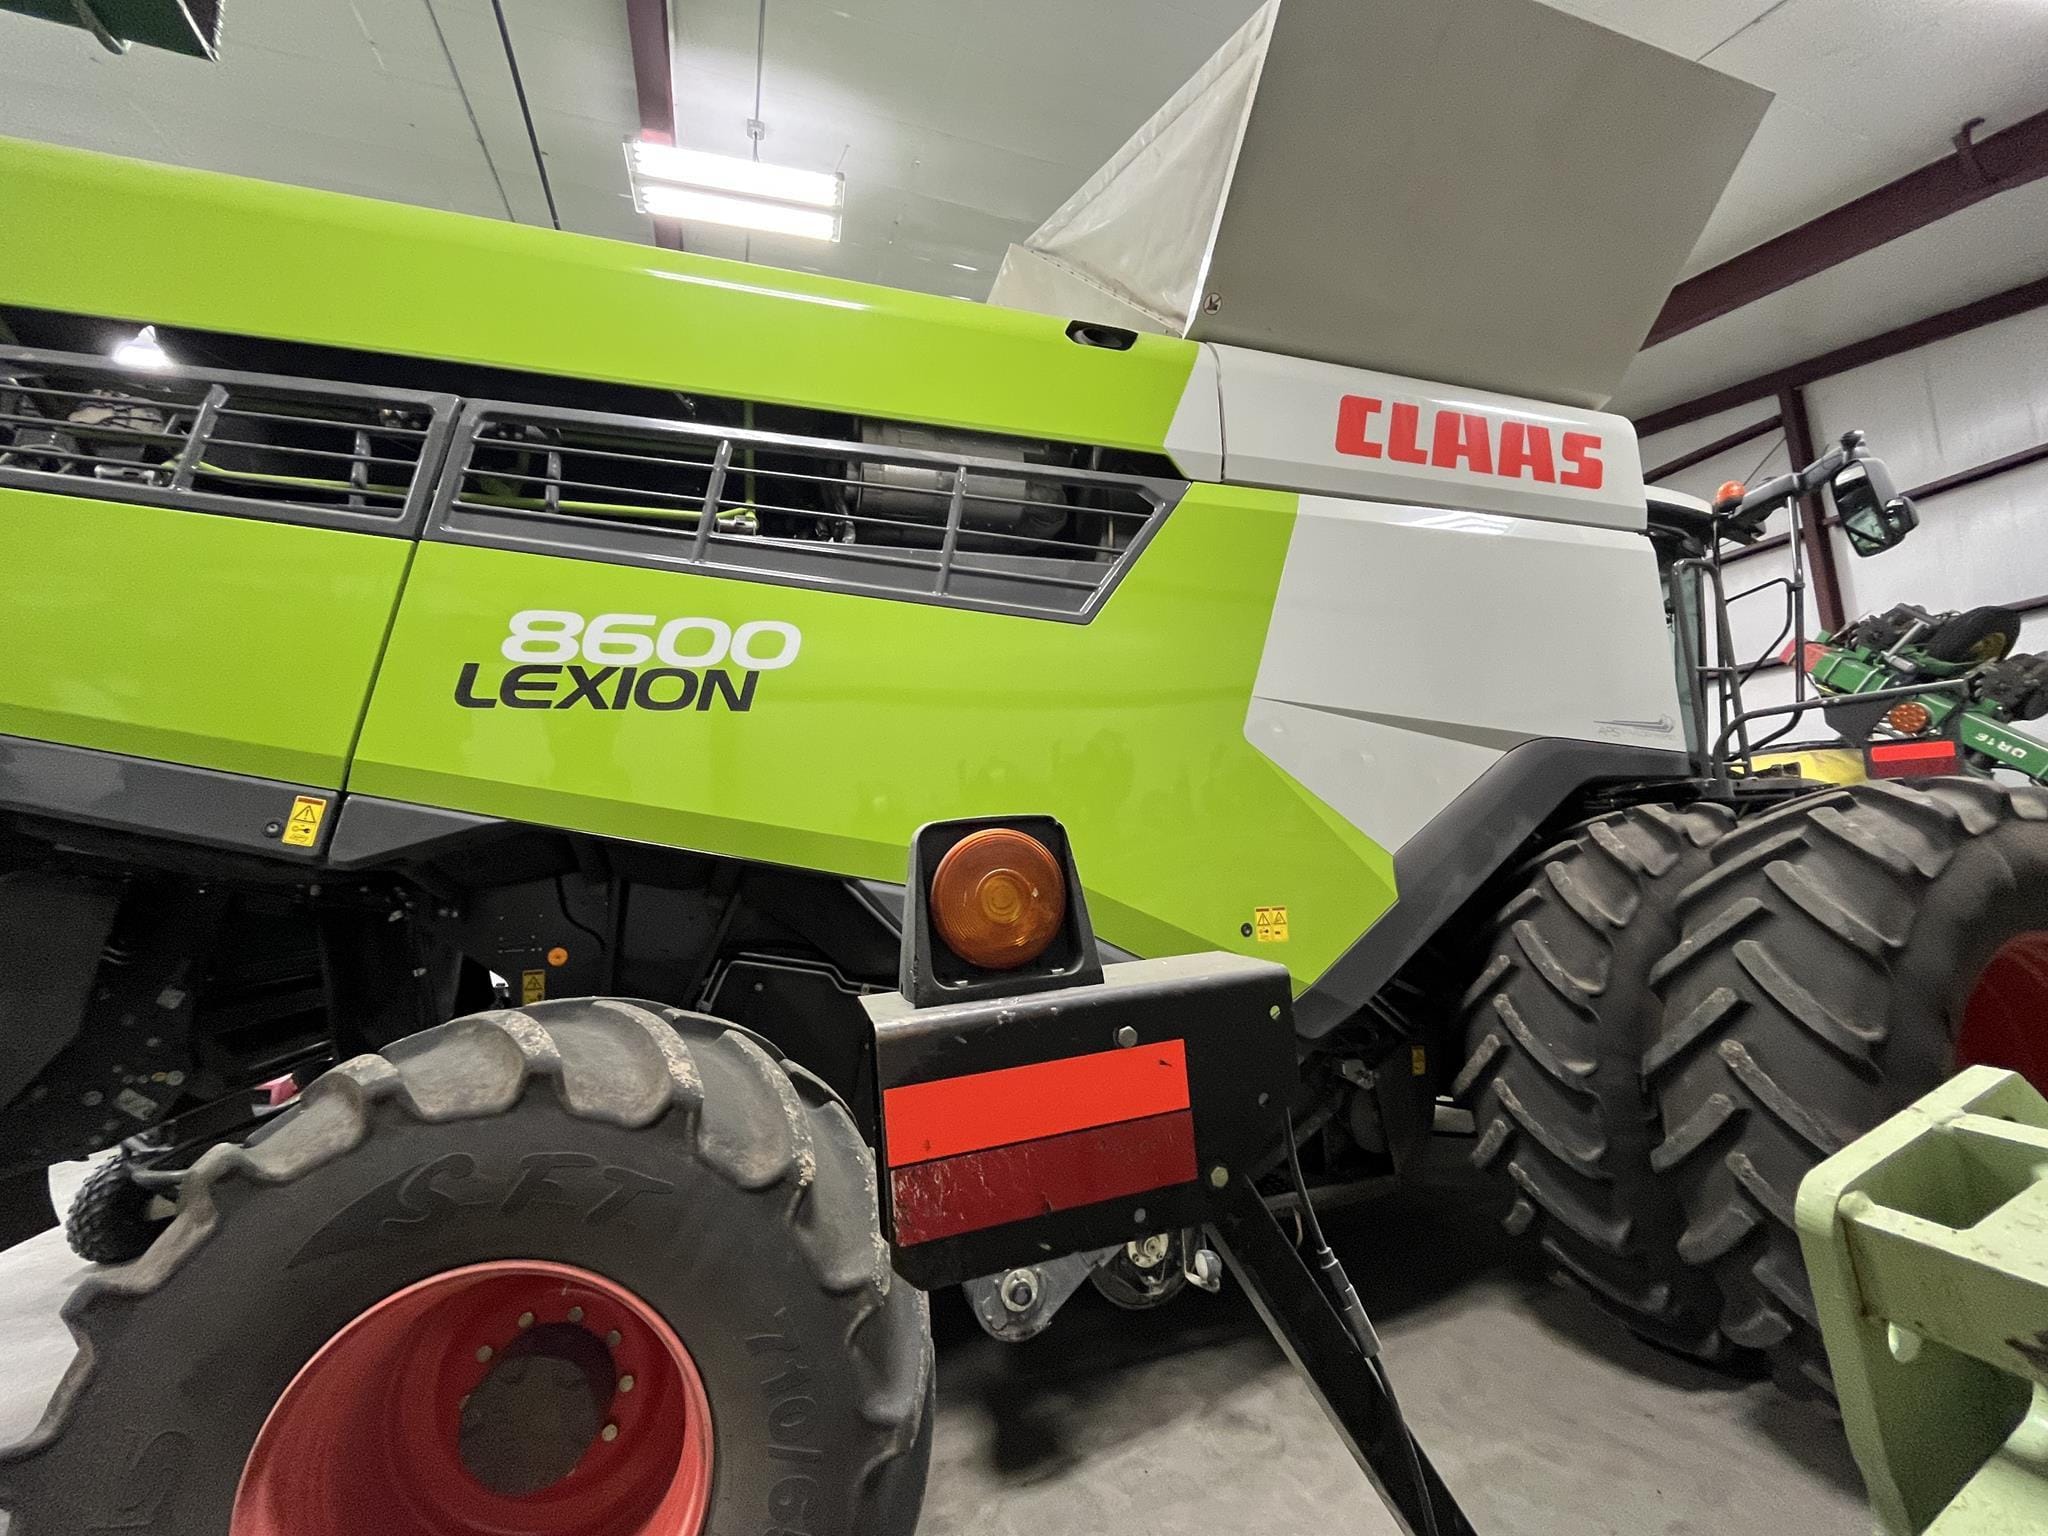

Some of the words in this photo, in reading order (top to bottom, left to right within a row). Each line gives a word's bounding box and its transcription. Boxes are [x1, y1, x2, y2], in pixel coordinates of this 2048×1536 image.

[1335, 394, 1604, 490] CLAAS
[501, 610, 801, 669] 8600
[454, 662, 760, 712] LEXION
